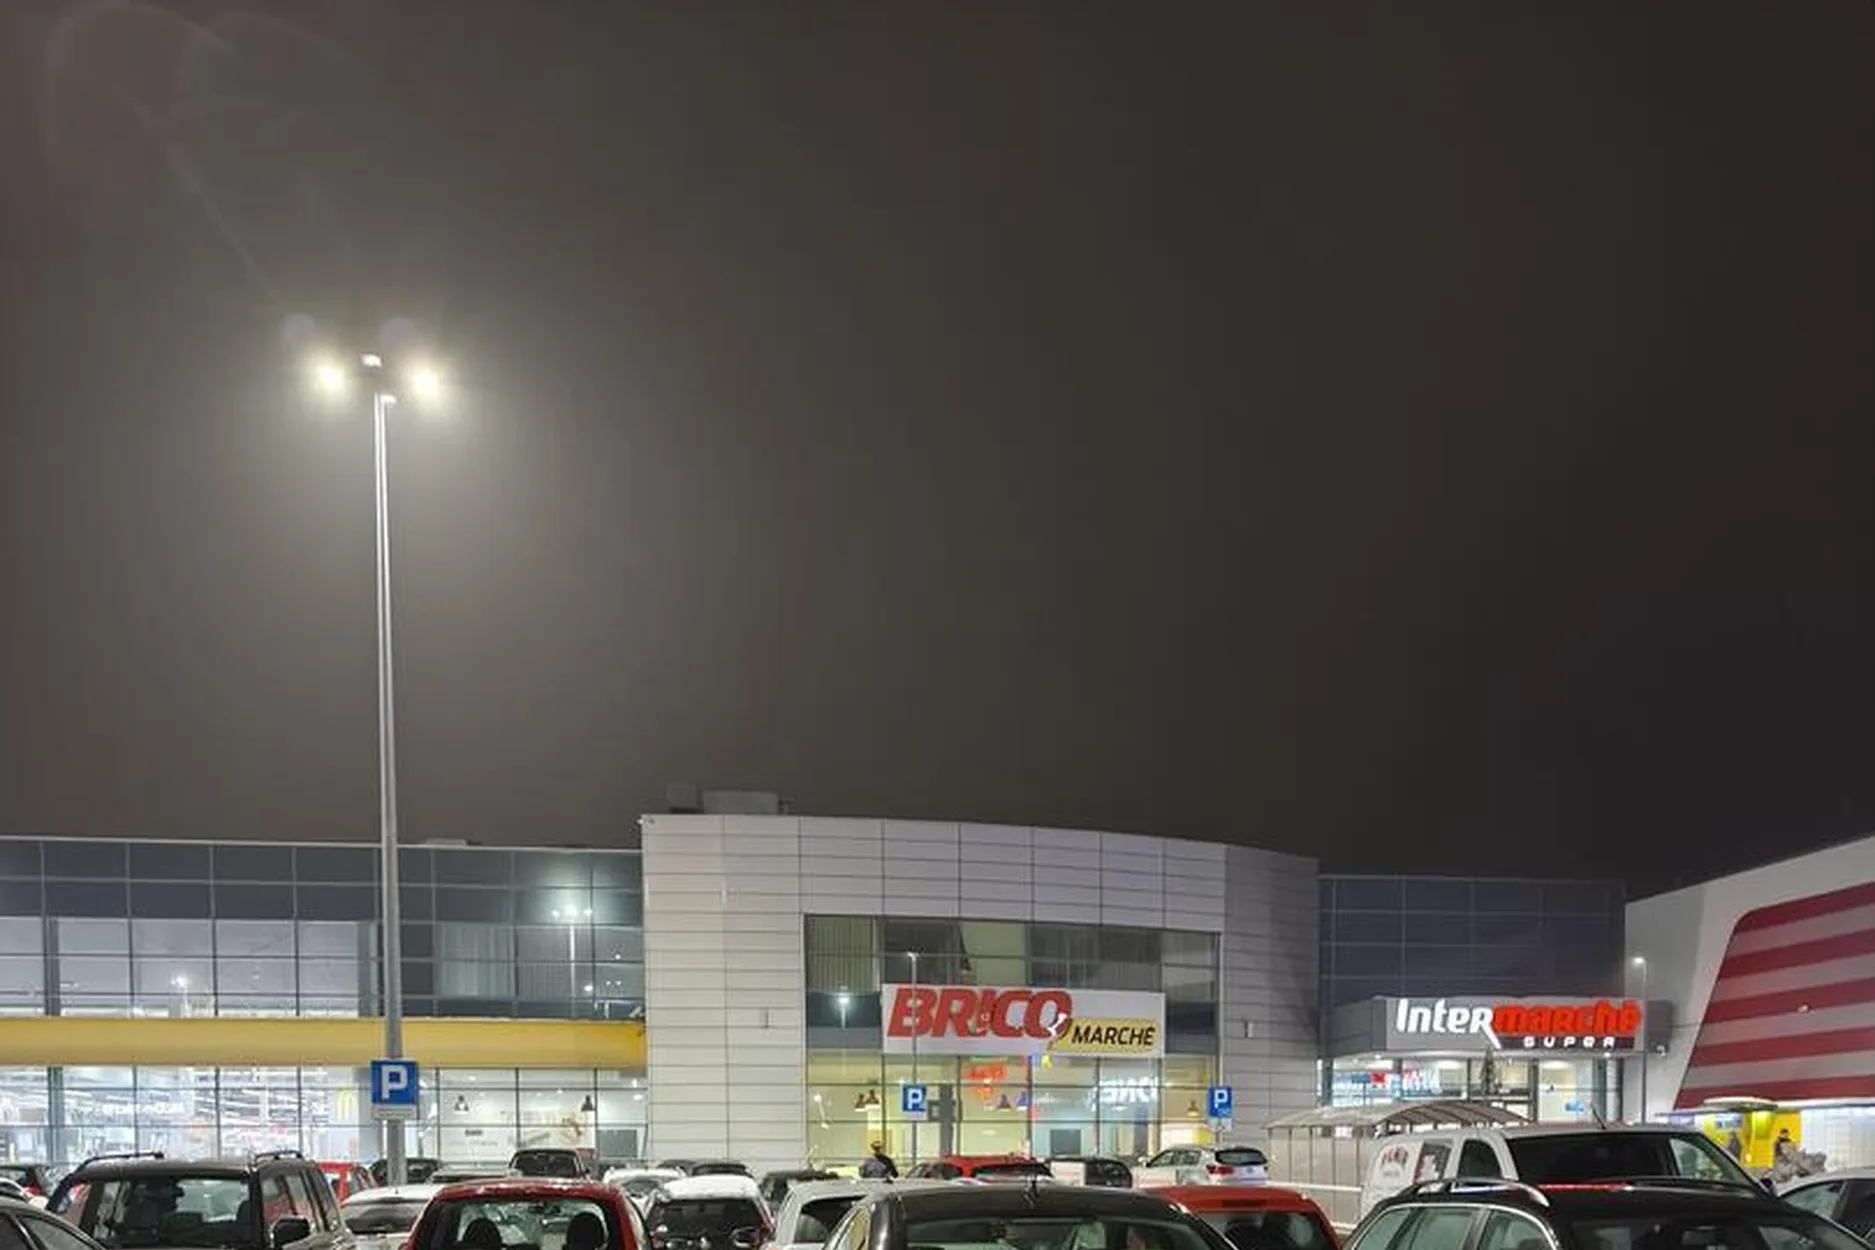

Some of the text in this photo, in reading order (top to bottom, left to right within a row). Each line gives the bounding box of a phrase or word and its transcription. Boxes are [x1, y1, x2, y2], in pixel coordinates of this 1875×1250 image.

[887, 987, 1073, 1039] BRICO
[1071, 1023, 1156, 1046] MARCHÉ
[1523, 1035, 1616, 1049] SUPER
[382, 1064, 408, 1099] P
[907, 1088, 923, 1110] P
[1214, 1089, 1228, 1109] P
